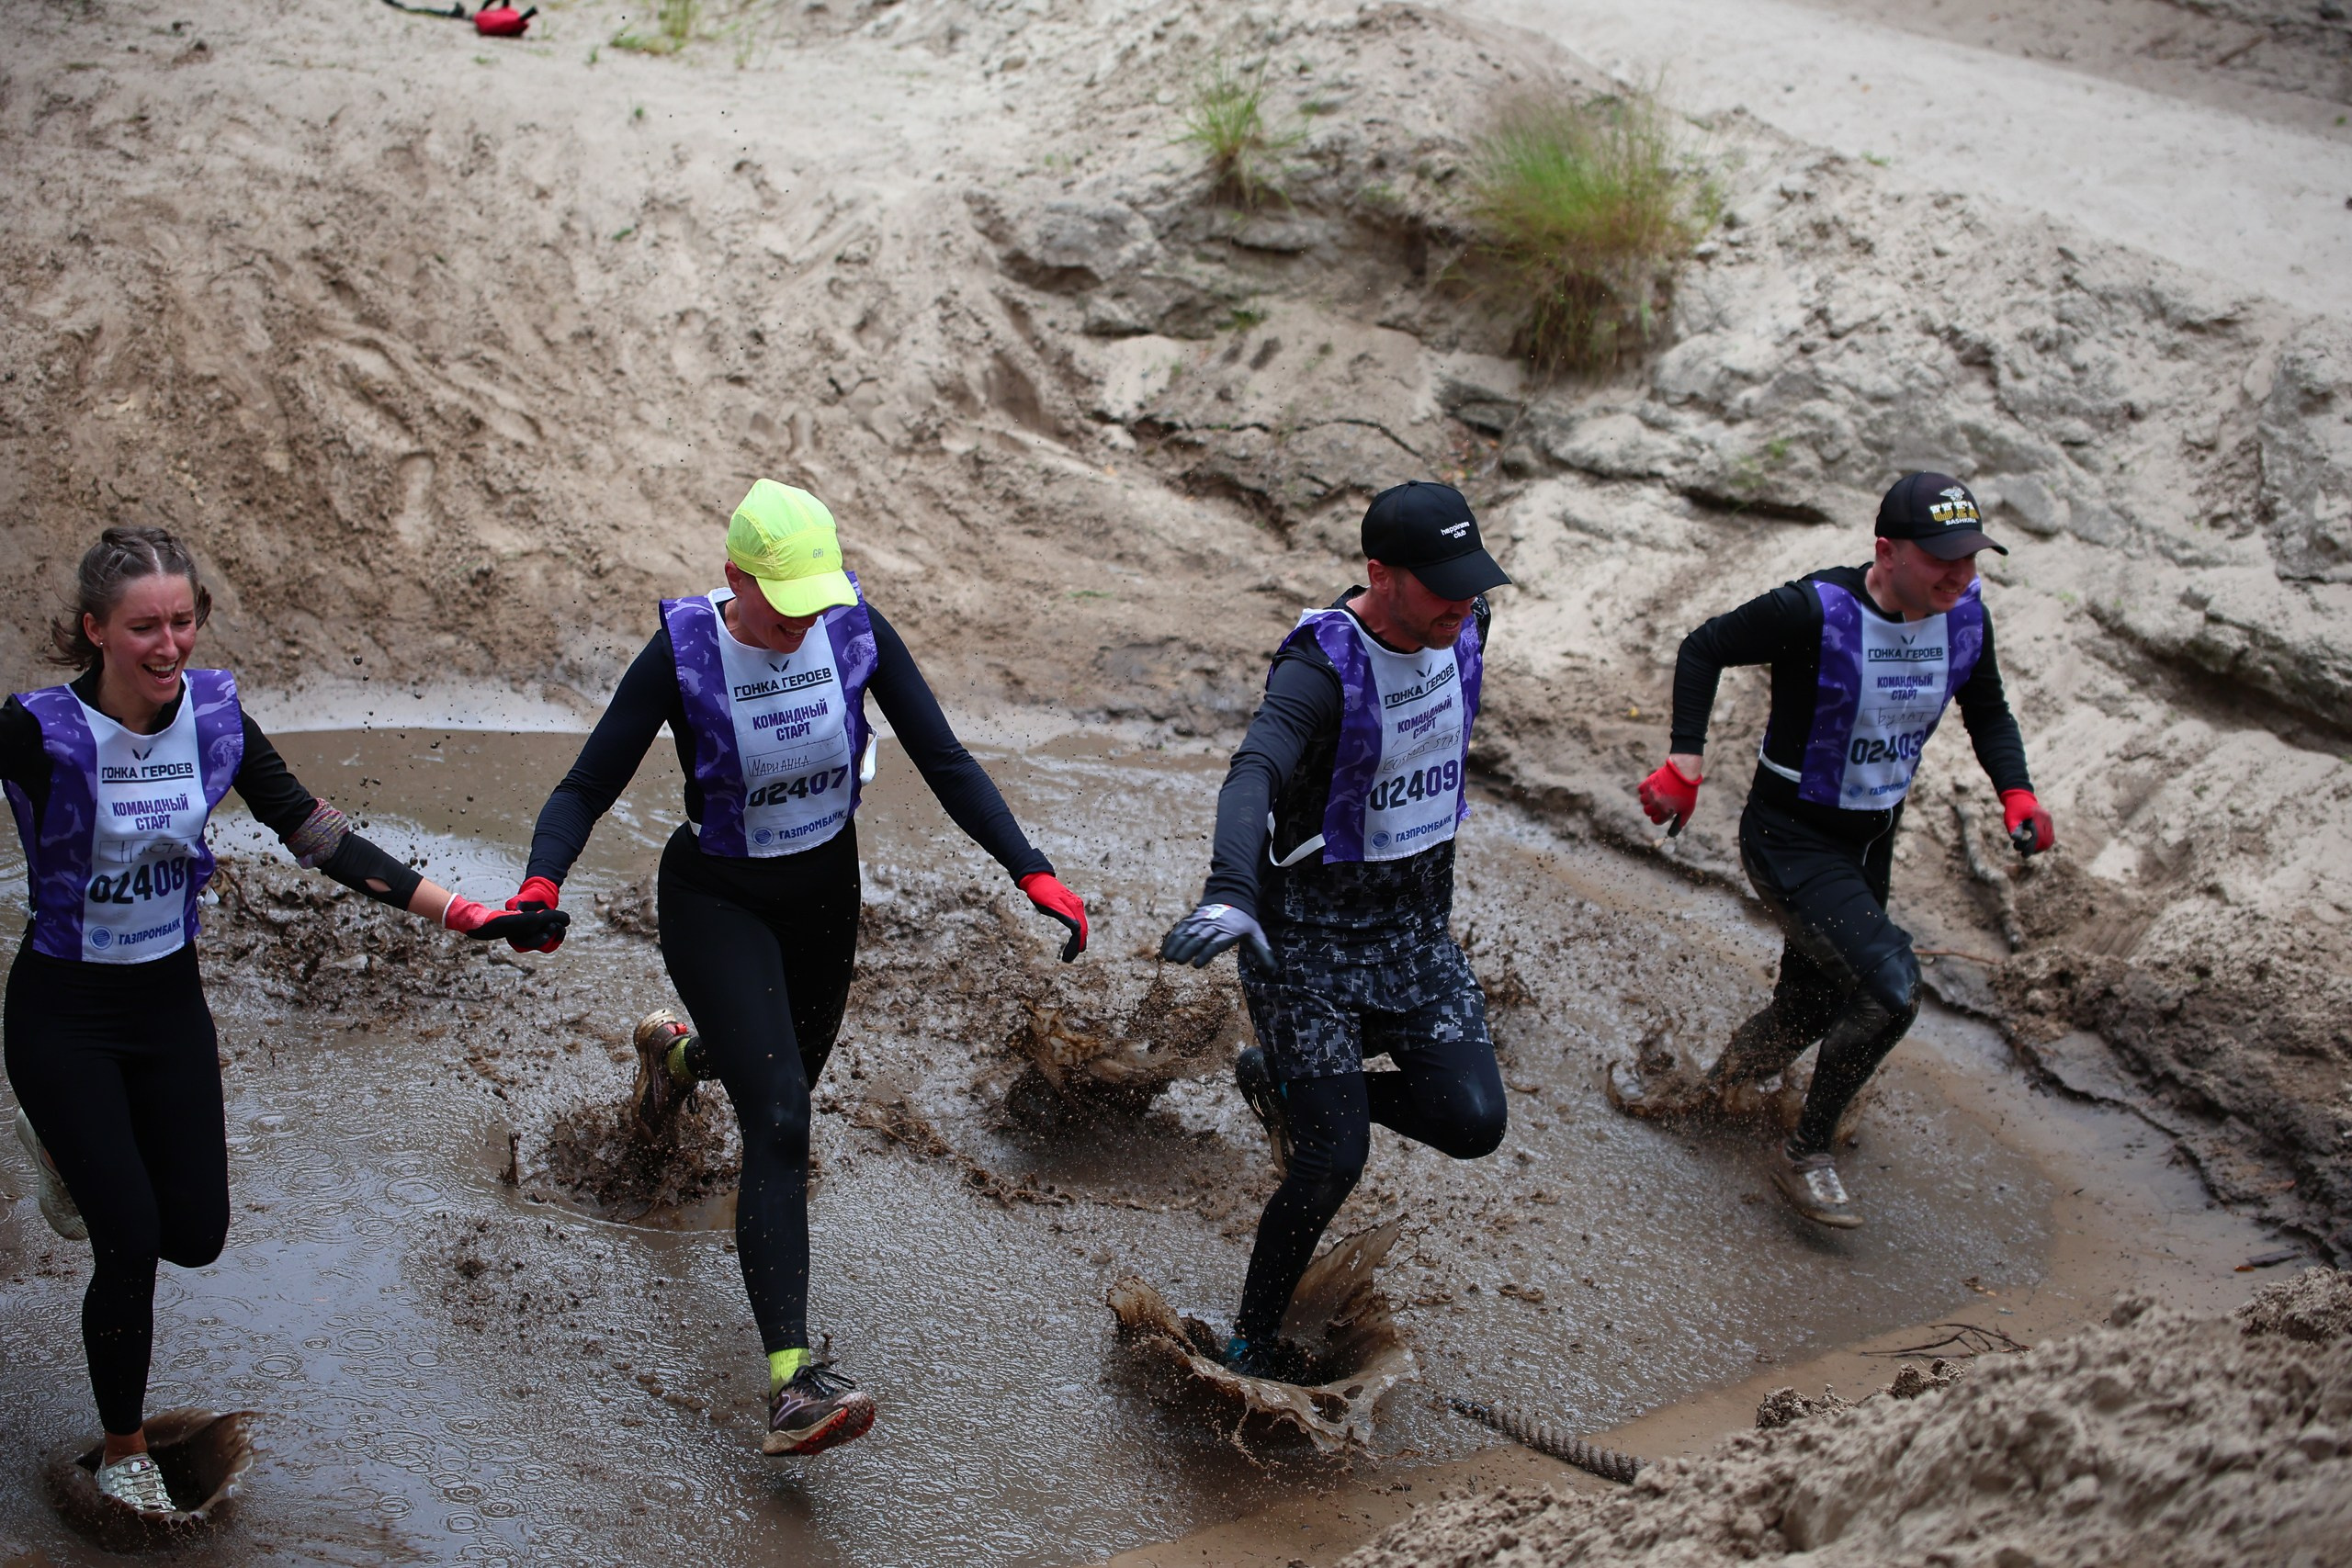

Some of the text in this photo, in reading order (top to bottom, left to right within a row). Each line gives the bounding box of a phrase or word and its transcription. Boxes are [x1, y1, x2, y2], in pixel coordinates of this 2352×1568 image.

[1453, 529, 1466, 538] club
[1868, 647, 1943, 659] ГОНКА ГЕРОЕВ
[734, 667, 832, 698] ГОНКА ГЕРОЕВ
[1385, 662, 1454, 705] ГОНКА ГЕРОЕВ
[1877, 672, 1933, 689] КОМАНДНЫЙ
[1891, 689, 1918, 700] СТАРТ
[752, 698, 829, 730] КОМАНДНЫЙ
[1397, 694, 1453, 734] КОМАНДНЫЙ
[1413, 716, 1437, 739] СТАРТ
[775, 722, 810, 741] СТАРТ
[1850, 729, 1925, 765] 02403
[102, 762, 194, 779] ГОНКА ГЕРОЕВ
[748, 763, 849, 807] 02407
[1370, 760, 1459, 811] 02409
[112, 794, 189, 817] КОМАНДНЫЙ
[135, 814, 171, 831] СТАРТ
[779, 809, 847, 840] ГАЗПРОМБАНК
[1396, 814, 1453, 843] ГАЗПРОМБАНК
[89, 856, 185, 905] 02408
[119, 918, 181, 946] ГАЗПРОМБАНК
